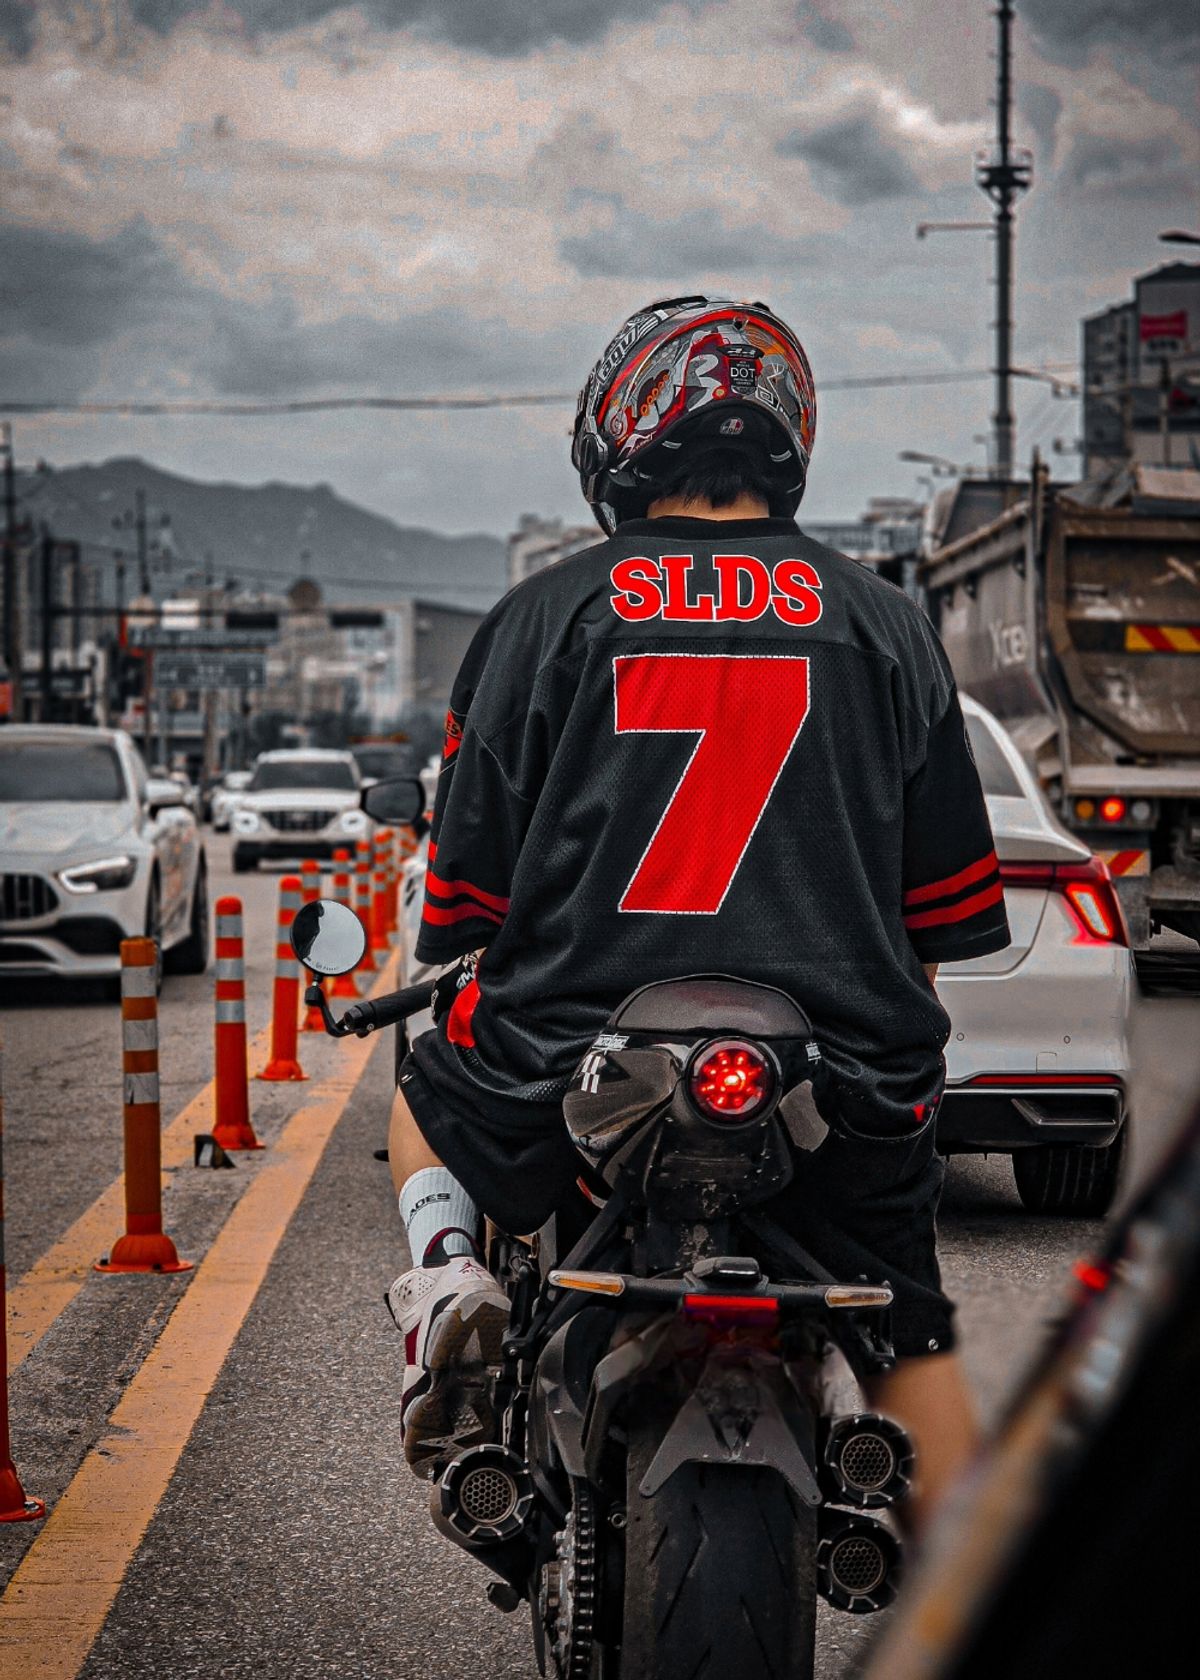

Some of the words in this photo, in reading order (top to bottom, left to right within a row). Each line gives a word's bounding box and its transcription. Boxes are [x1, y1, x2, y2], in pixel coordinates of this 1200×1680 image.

[730, 367, 755, 377] DOT
[610, 554, 823, 627] SLDS
[613, 653, 810, 915] 7
